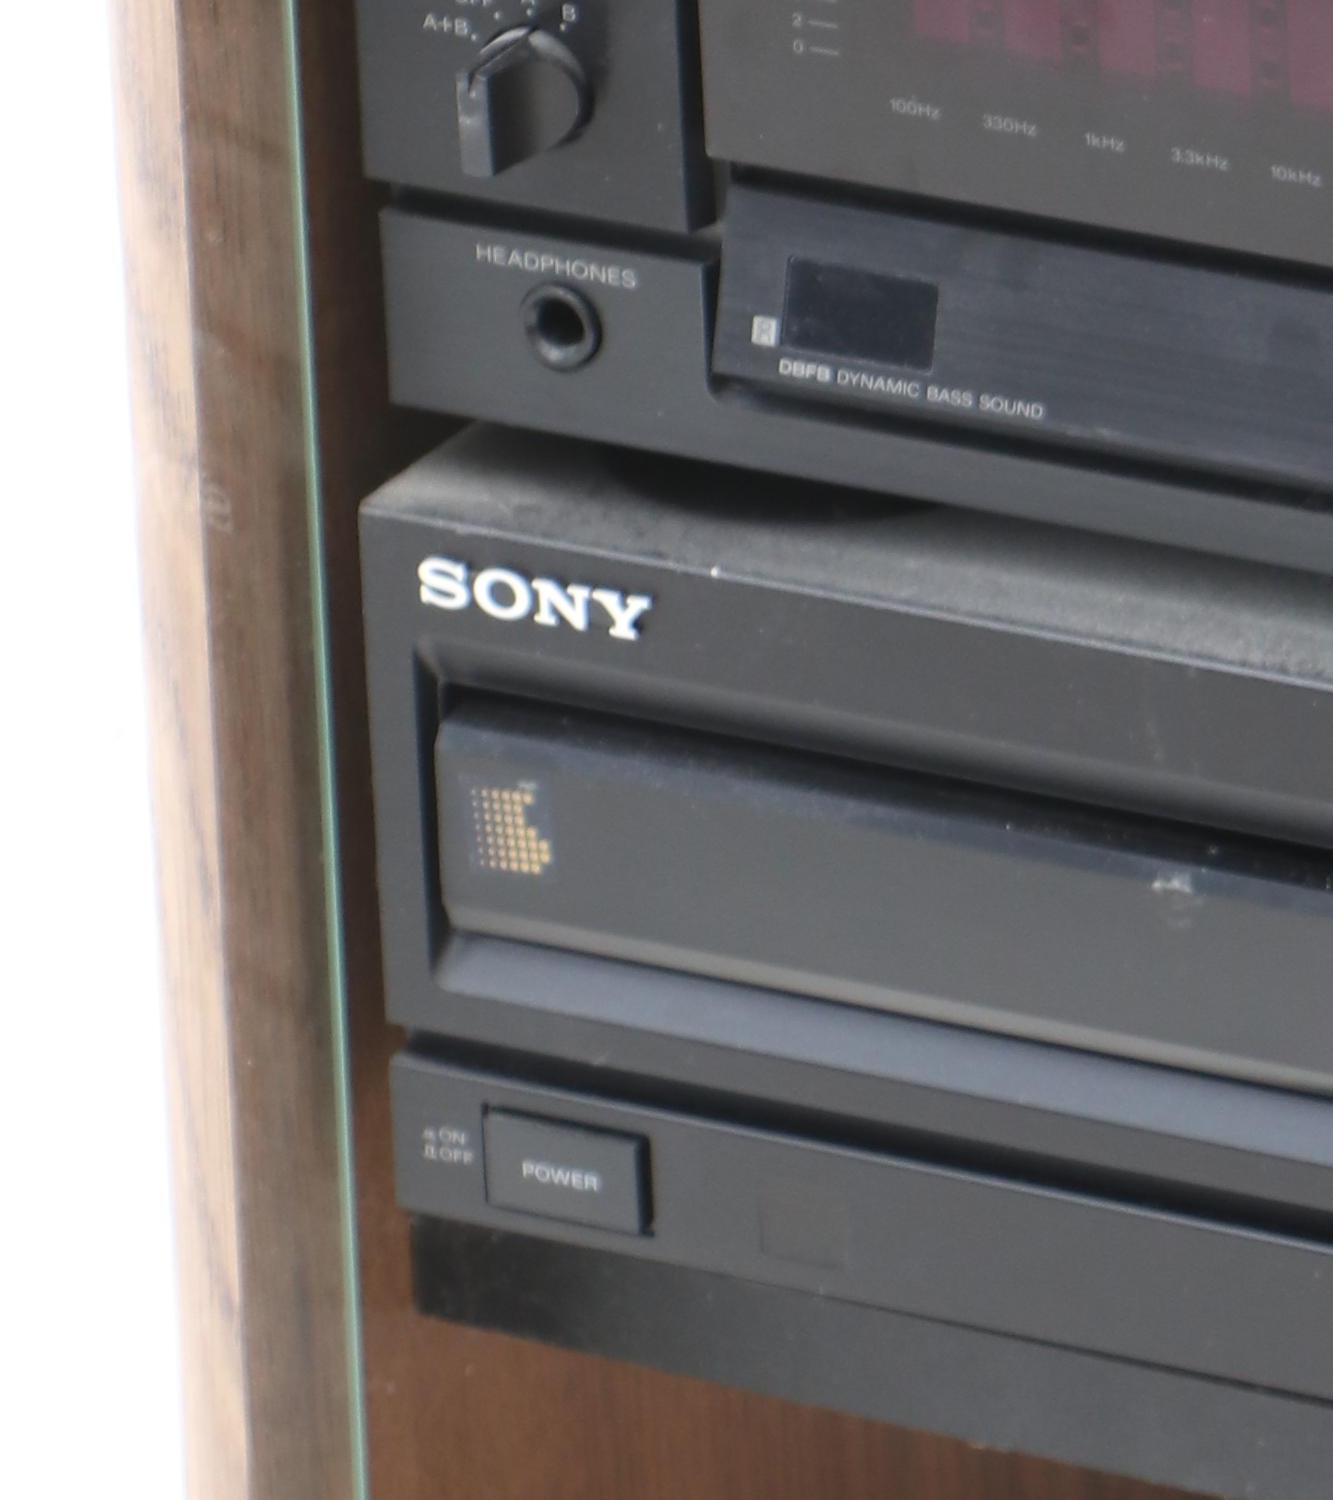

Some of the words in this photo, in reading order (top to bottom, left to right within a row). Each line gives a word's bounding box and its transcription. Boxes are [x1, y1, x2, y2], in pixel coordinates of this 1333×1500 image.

[475, 244, 637, 289] HEADPHONES
[778, 358, 831, 382] DBFB
[837, 370, 919, 398] DYNAMIC
[927, 385, 972, 408] BASS
[979, 394, 1045, 419] SOUND
[417, 556, 651, 640] SONY
[522, 1160, 600, 1191] POWER
